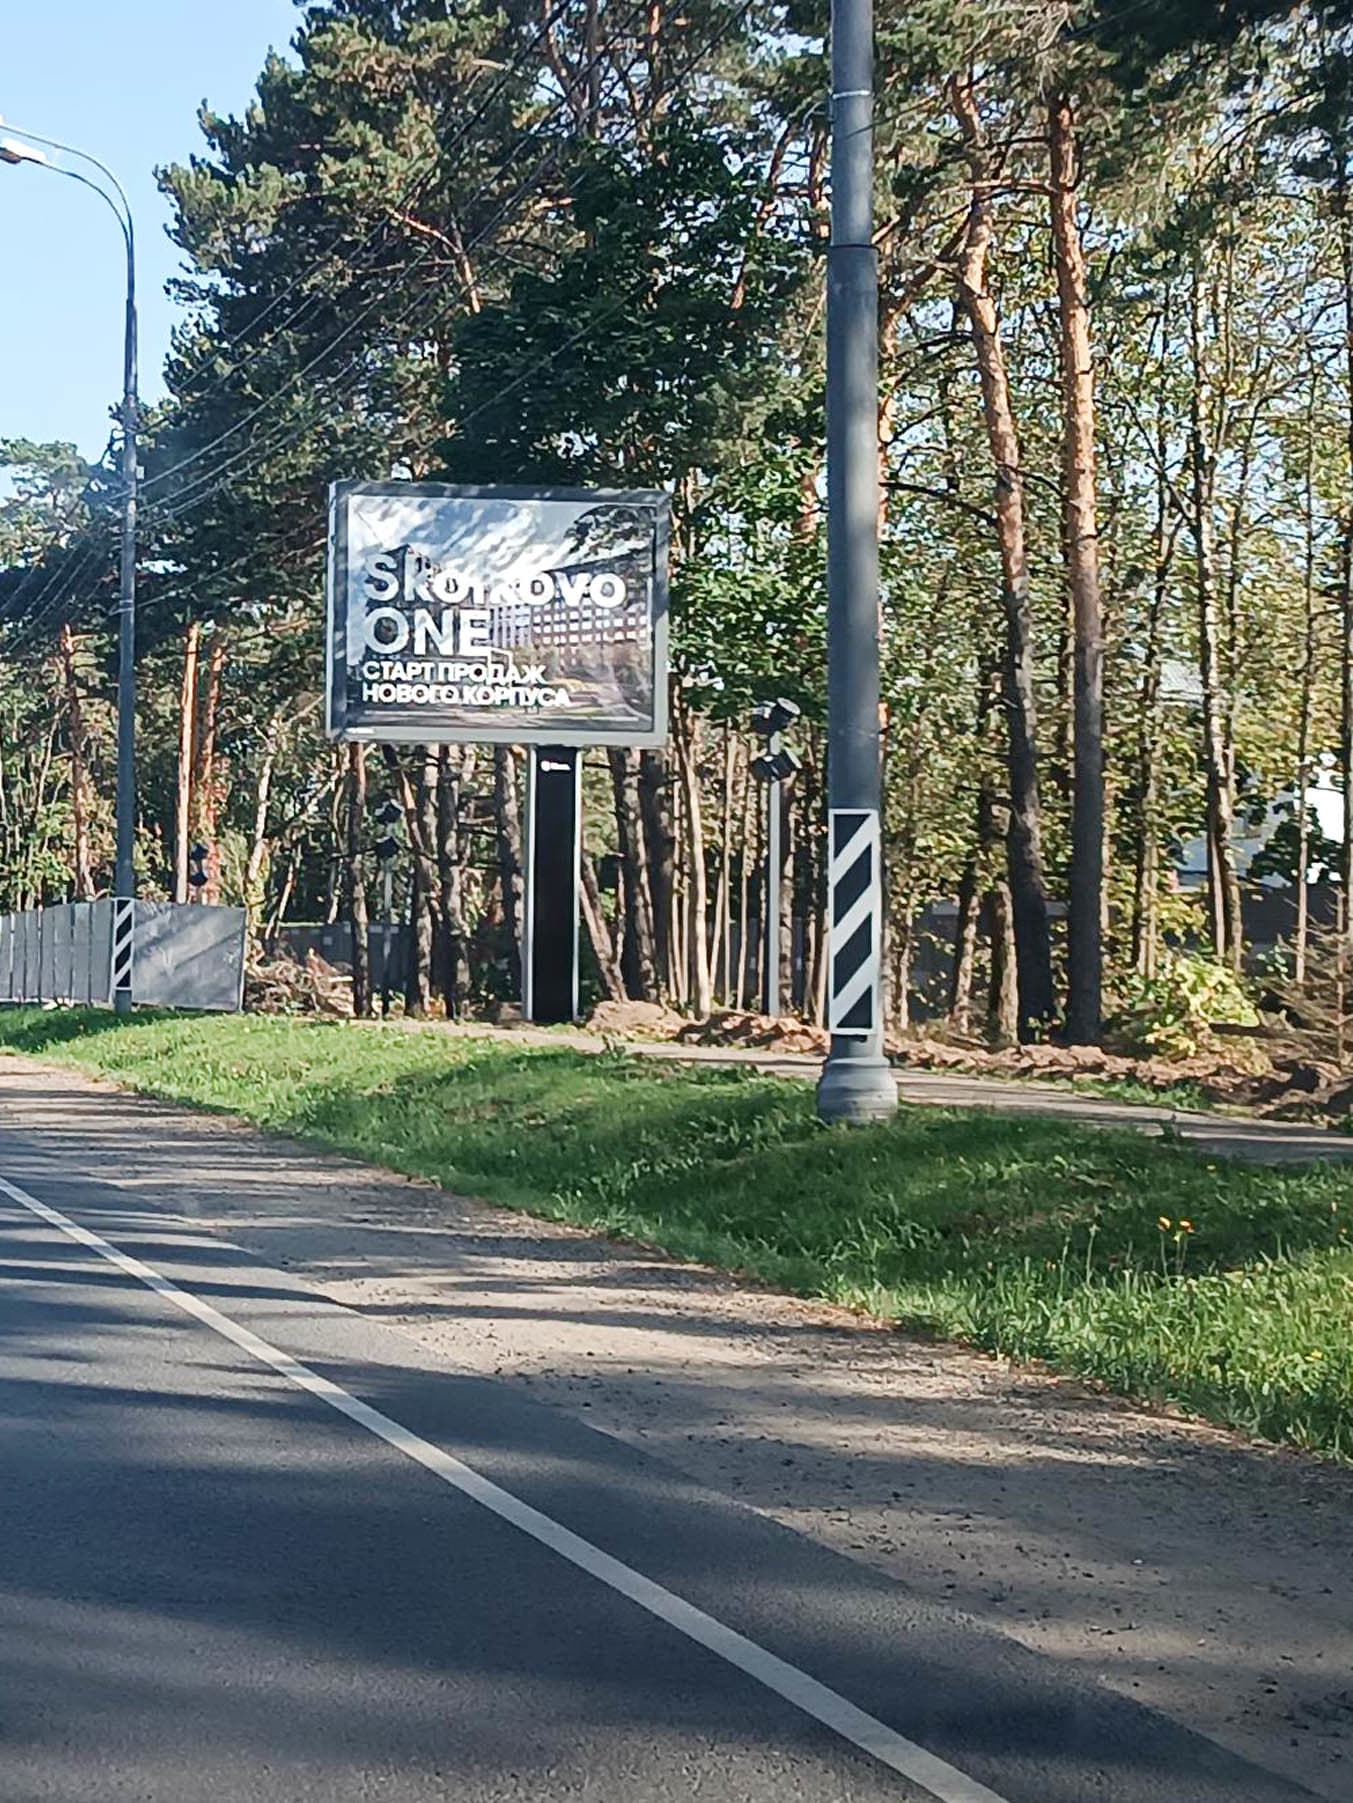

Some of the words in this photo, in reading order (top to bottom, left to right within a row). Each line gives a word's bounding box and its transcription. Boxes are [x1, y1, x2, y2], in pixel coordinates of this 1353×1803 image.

[363, 607, 491, 657] ONE
[363, 660, 435, 682] СТАРТ
[438, 662, 547, 686] ПРОДАЖ
[362, 682, 460, 705] НОВОГО
[462, 685, 572, 708] КОРПУСА
